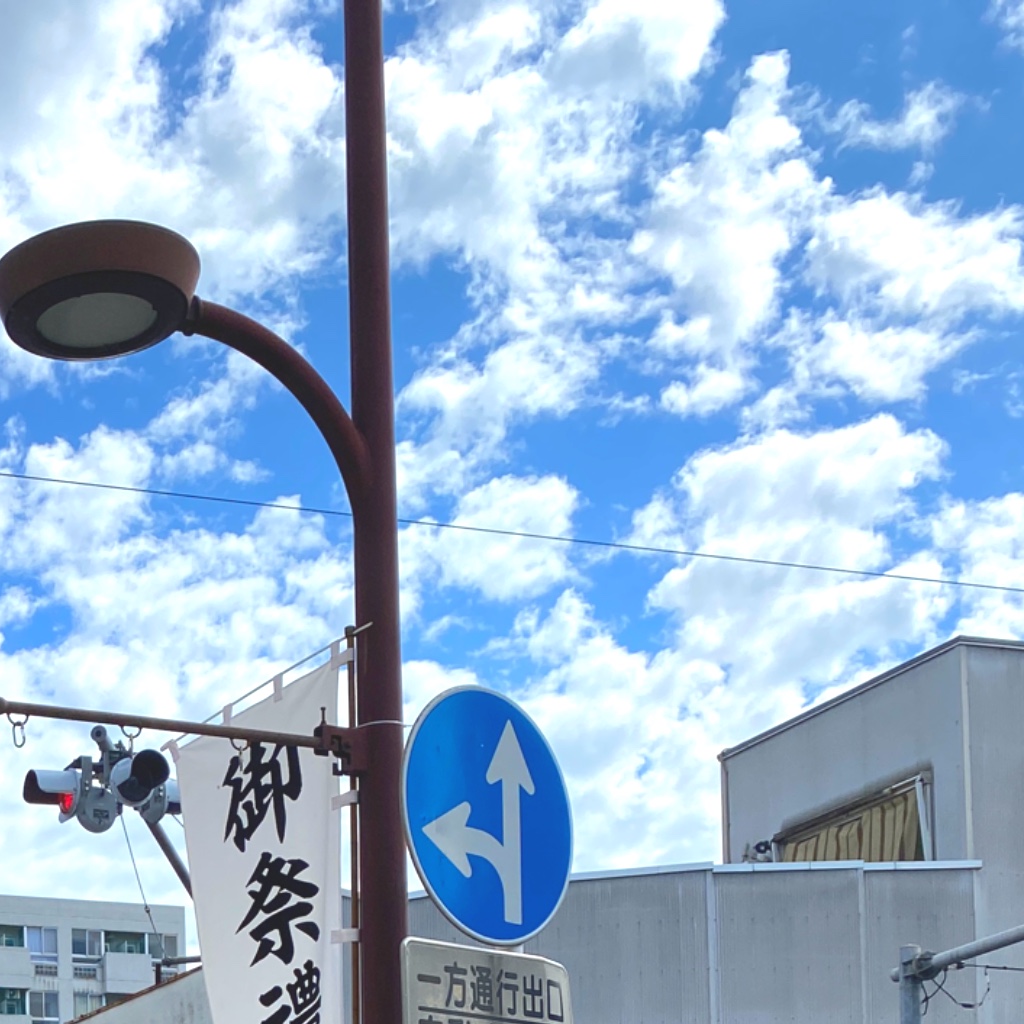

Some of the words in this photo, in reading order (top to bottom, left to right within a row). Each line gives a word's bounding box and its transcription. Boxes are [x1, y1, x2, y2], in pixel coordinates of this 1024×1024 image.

[417, 962, 564, 1023] 一方通行出口
